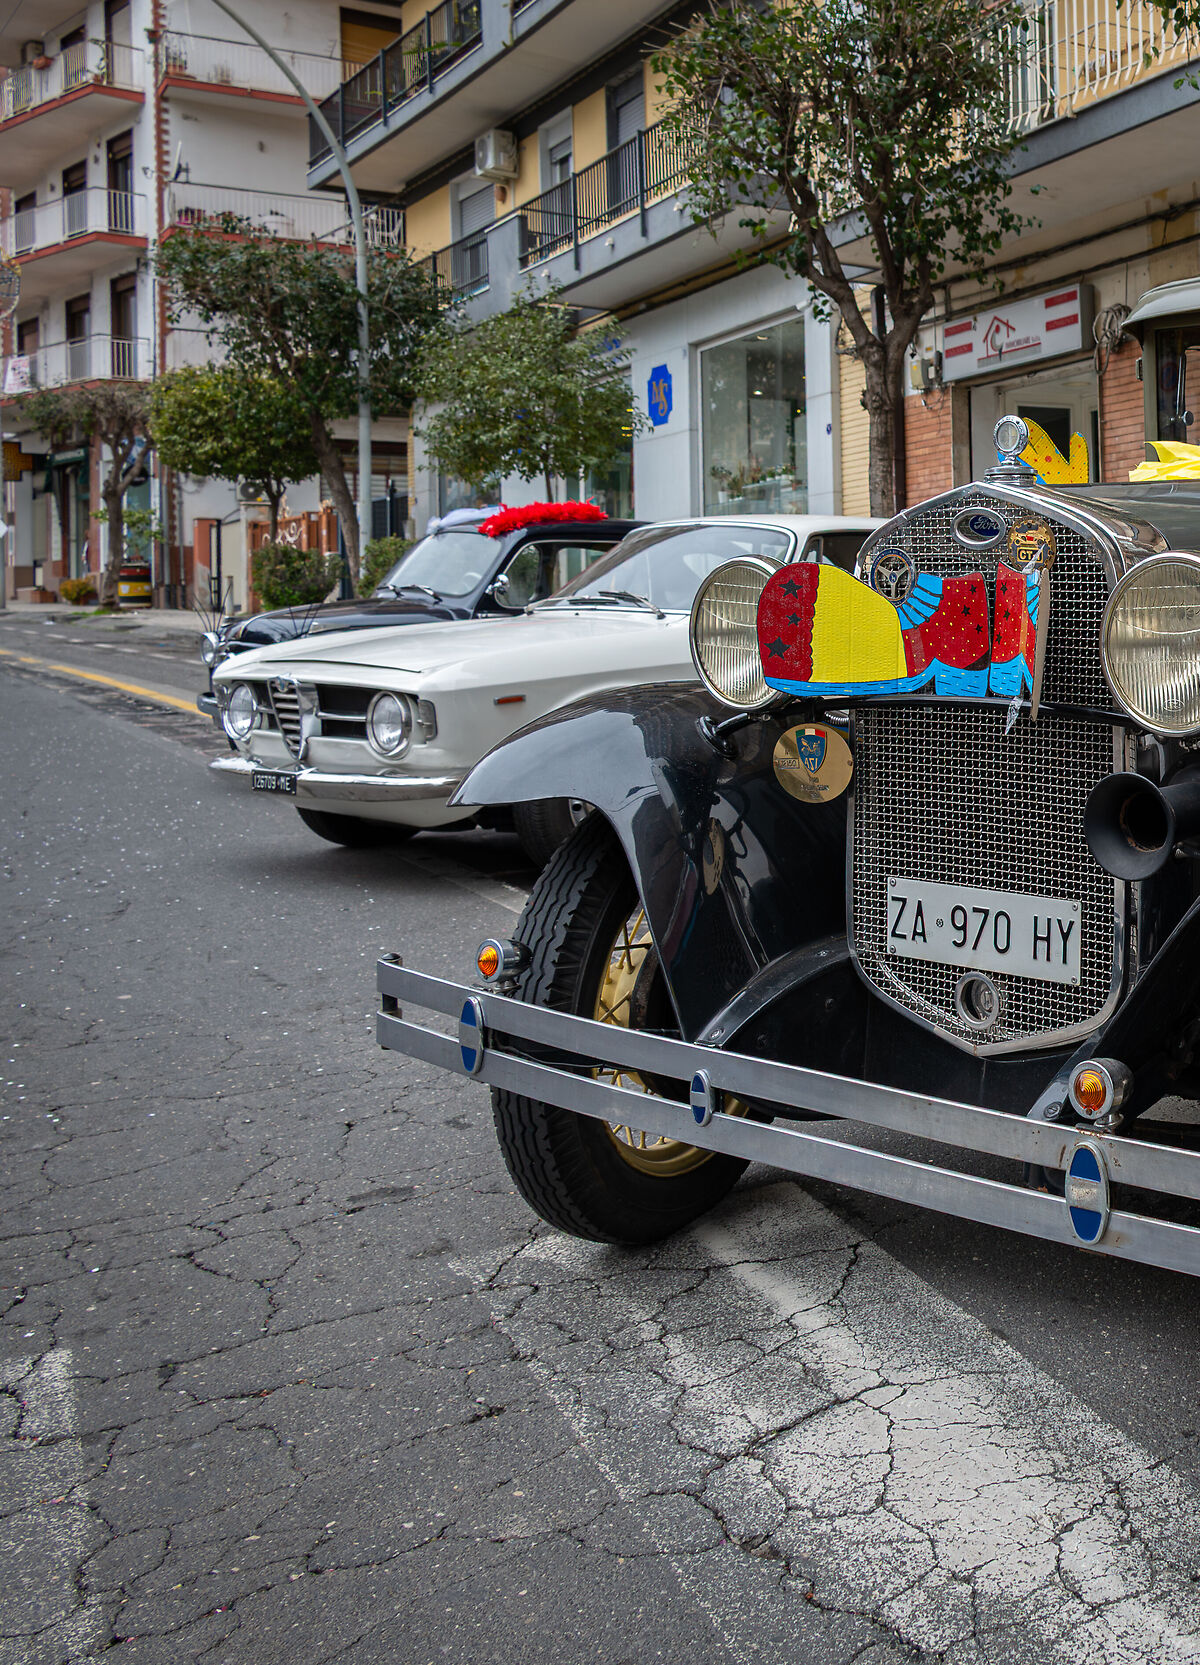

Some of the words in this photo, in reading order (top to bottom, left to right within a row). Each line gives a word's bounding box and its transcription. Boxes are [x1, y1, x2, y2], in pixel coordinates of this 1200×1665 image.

[890, 895, 927, 944] ZA
[950, 904, 1012, 954] 970
[1031, 915, 1076, 965] HY
